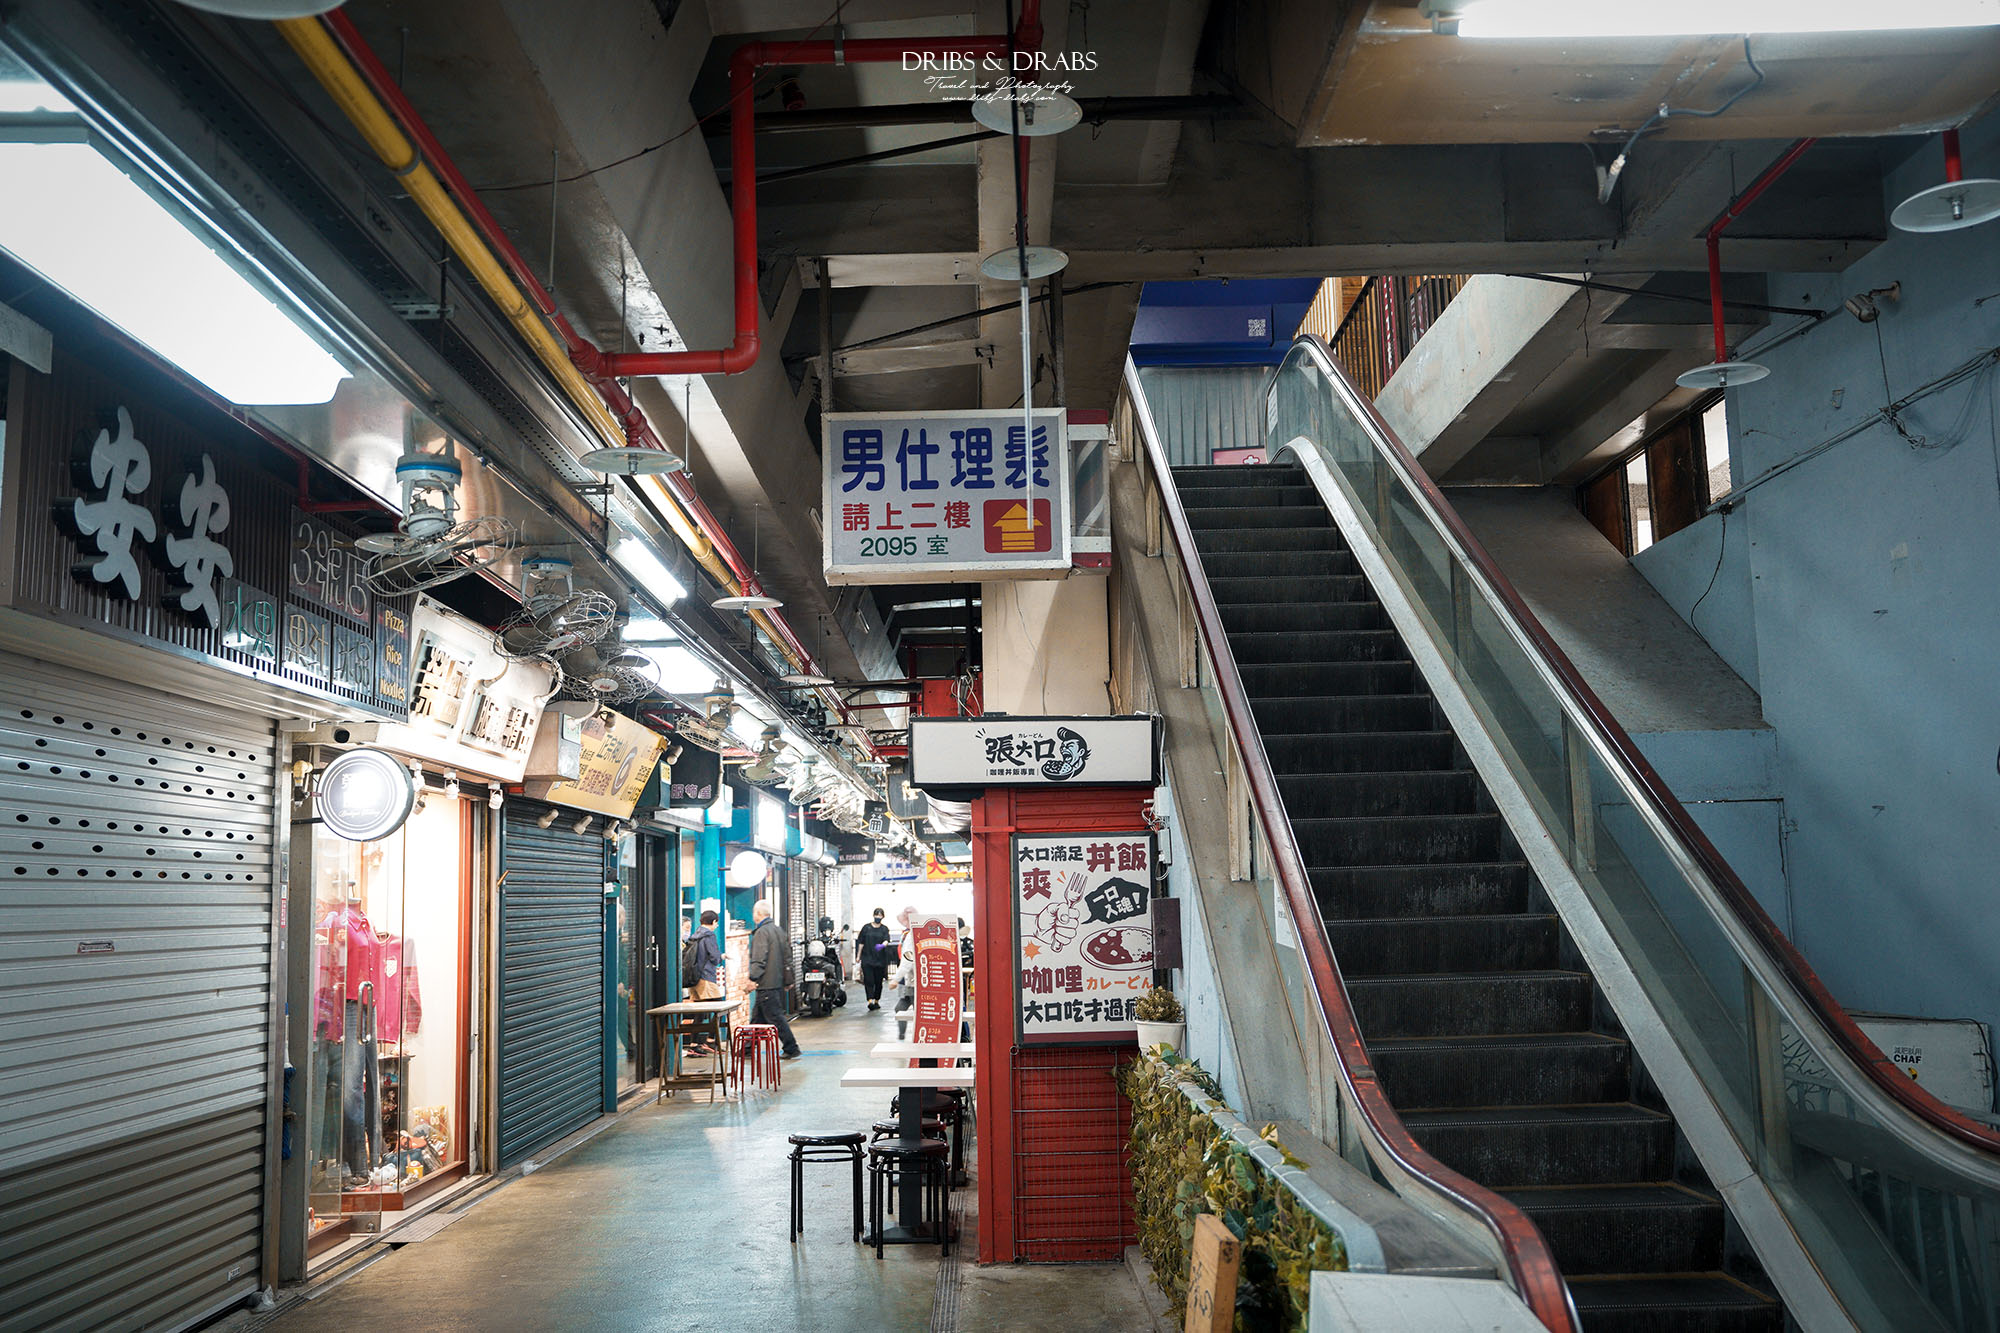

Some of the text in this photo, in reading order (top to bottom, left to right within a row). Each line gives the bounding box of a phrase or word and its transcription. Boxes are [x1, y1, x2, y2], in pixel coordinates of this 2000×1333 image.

[841, 424, 1050, 492] 男仕理髮
[75, 405, 234, 629] 安安
[842, 501, 971, 531] 請上二樓
[860, 535, 949, 557] 2095 室
[385, 609, 404, 634] Pizza
[385, 644, 402, 666] Rice
[379, 678, 405, 702] Noodles
[985, 734, 1056, 766] 張大口
[1019, 842, 1147, 872] 大口滿足 丼飯
[1022, 868, 1052, 900] 爽
[1021, 965, 1083, 994] 咖哩
[1086, 975, 1153, 991] カレーどん
[1893, 1054, 1922, 1063] CHAF
